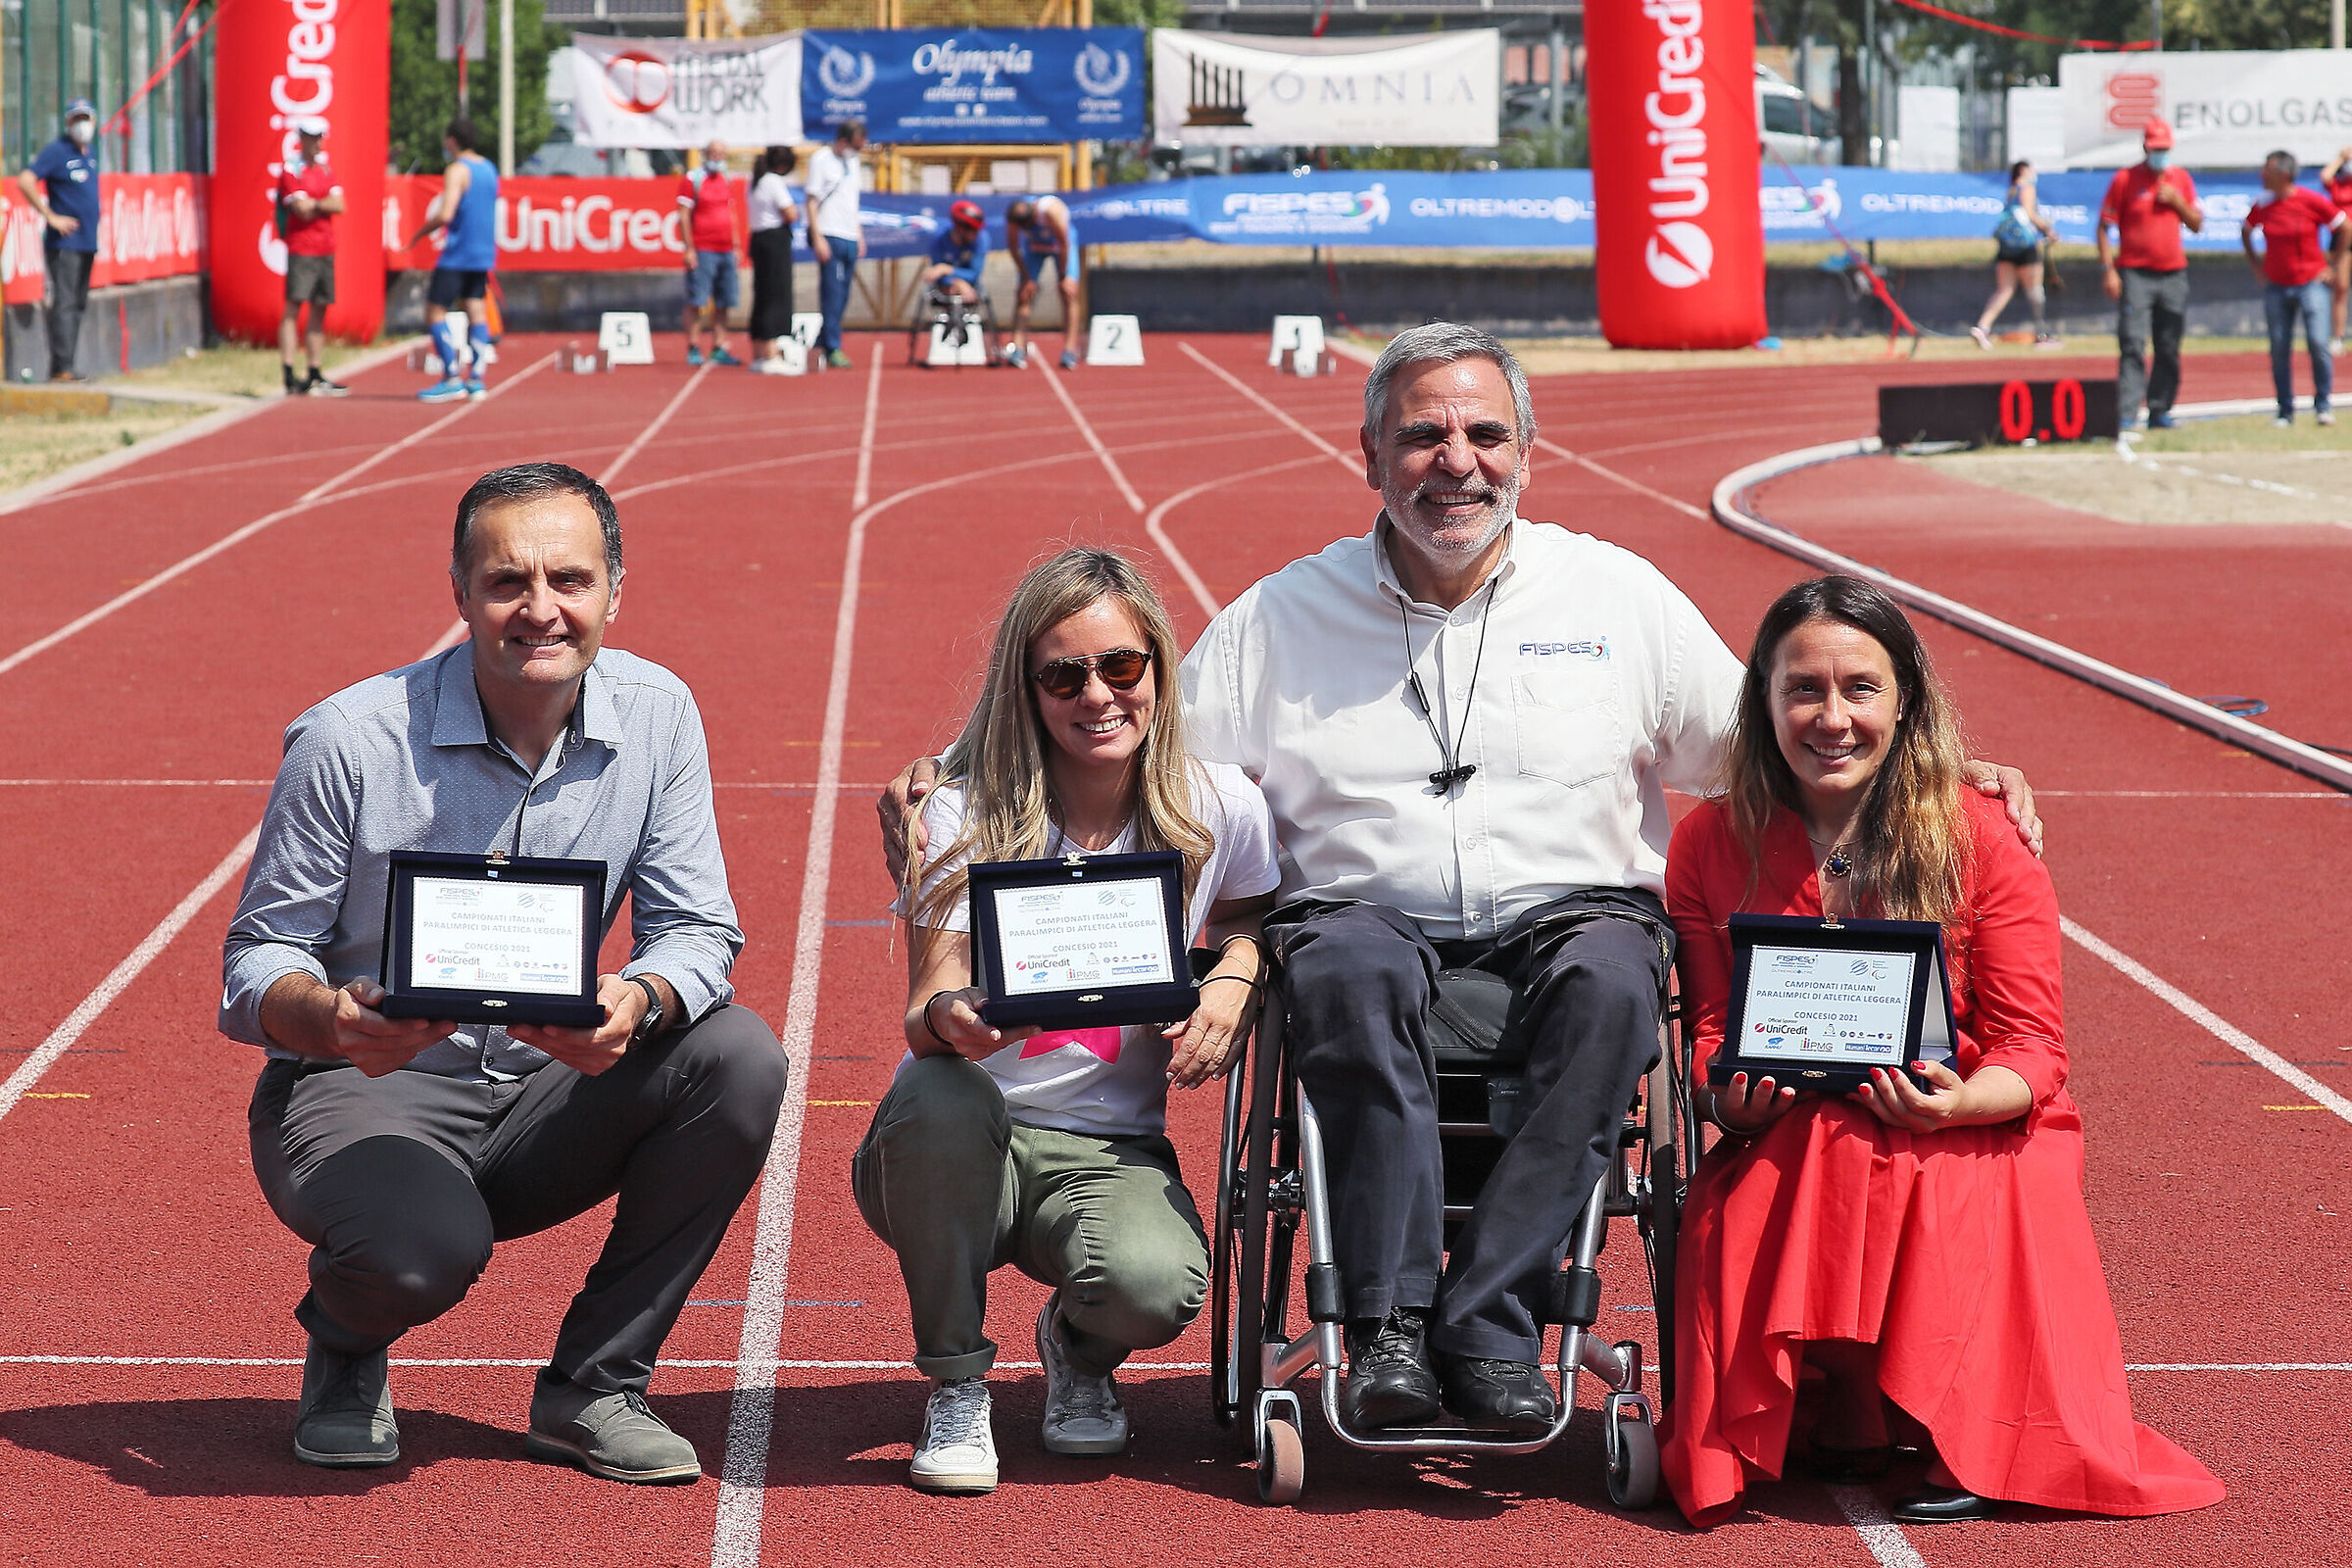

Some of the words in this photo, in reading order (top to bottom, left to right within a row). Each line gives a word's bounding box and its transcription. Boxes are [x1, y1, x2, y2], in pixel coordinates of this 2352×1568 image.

[912, 38, 1033, 85] Olympia
[1269, 70, 1475, 105] OMNIA
[673, 76, 770, 115] WORK
[1642, 0, 1710, 218] UniCred
[2174, 98, 2352, 128] ENOLGAS
[1223, 192, 1354, 216] FISPES
[614, 321, 631, 348] 5
[1106, 323, 1123, 350] 2
[1999, 378, 2085, 442] 0.0
[1519, 641, 1592, 656] FISPES
[451, 912, 507, 922] CAMPIONATI
[509, 915, 546, 924] ITALIANI
[1036, 913, 1090, 925] CAMPIONATI
[1092, 911, 1128, 921] ITALIANI
[423, 921, 479, 931] PARALIMPICI
[493, 925, 531, 934] ATLETICA
[1008, 926, 1064, 938] PARALIMPICI
[1077, 923, 1116, 933] ATLETICA
[1118, 919, 1157, 929] LEGGERA
[465, 942, 510, 952] CONCESIO
[1052, 942, 1097, 953] CONCESIO
[437, 956, 480, 966] UniCredit
[1027, 958, 1070, 970] UniCredit
[1776, 955, 1811, 963] FISPES
[1785, 980, 1838, 990] CAMPIONATI
[1839, 983, 1876, 992] ITALIANI
[1756, 990, 1810, 1000] PARALIMPICI
[1823, 994, 1861, 1003] ATLETICA
[1863, 996, 1901, 1004] LEGGERA
[1793, 1011, 1838, 1020] CONCESIO
[1766, 1024, 1808, 1035] UniCredit
